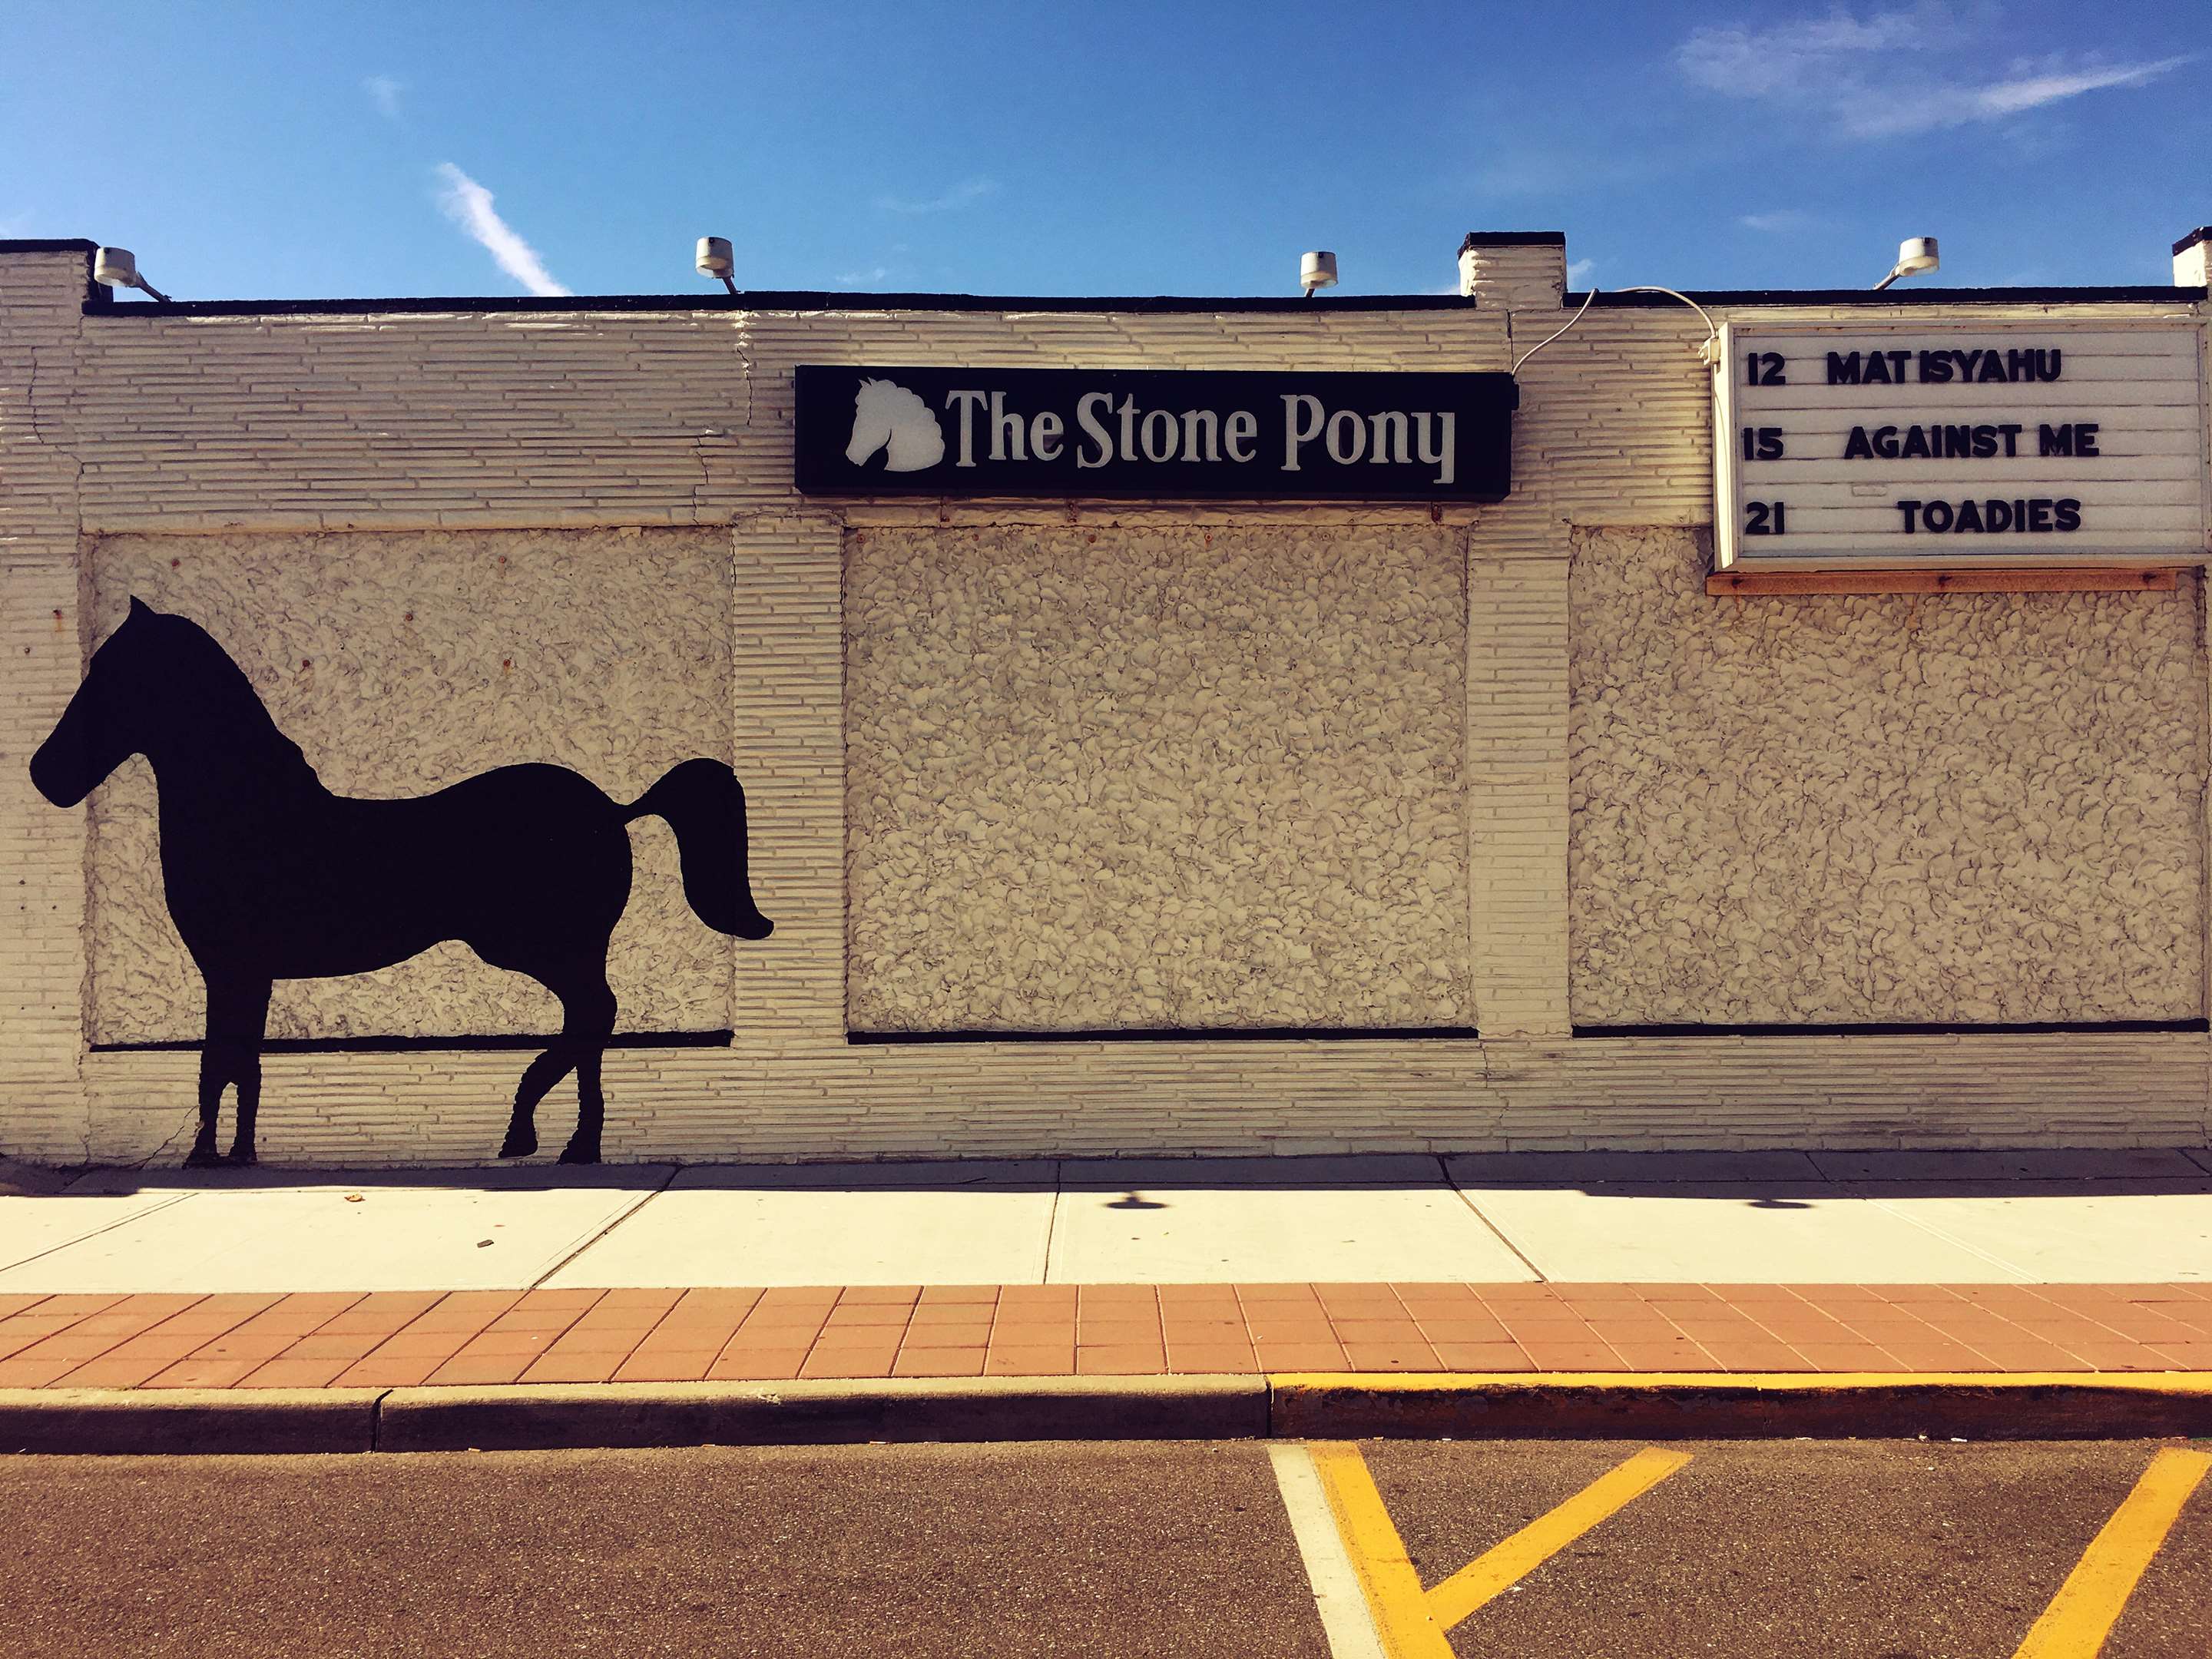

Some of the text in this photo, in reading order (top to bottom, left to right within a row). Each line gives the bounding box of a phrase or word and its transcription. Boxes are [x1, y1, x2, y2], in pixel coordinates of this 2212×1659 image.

[1748, 349, 2061, 385] 12 MATISYAHU
[945, 389, 1455, 484] The Stone Pony
[1743, 423, 2100, 460] 15 AGAINST ME
[1745, 498, 2082, 535] 21 TOADIES
